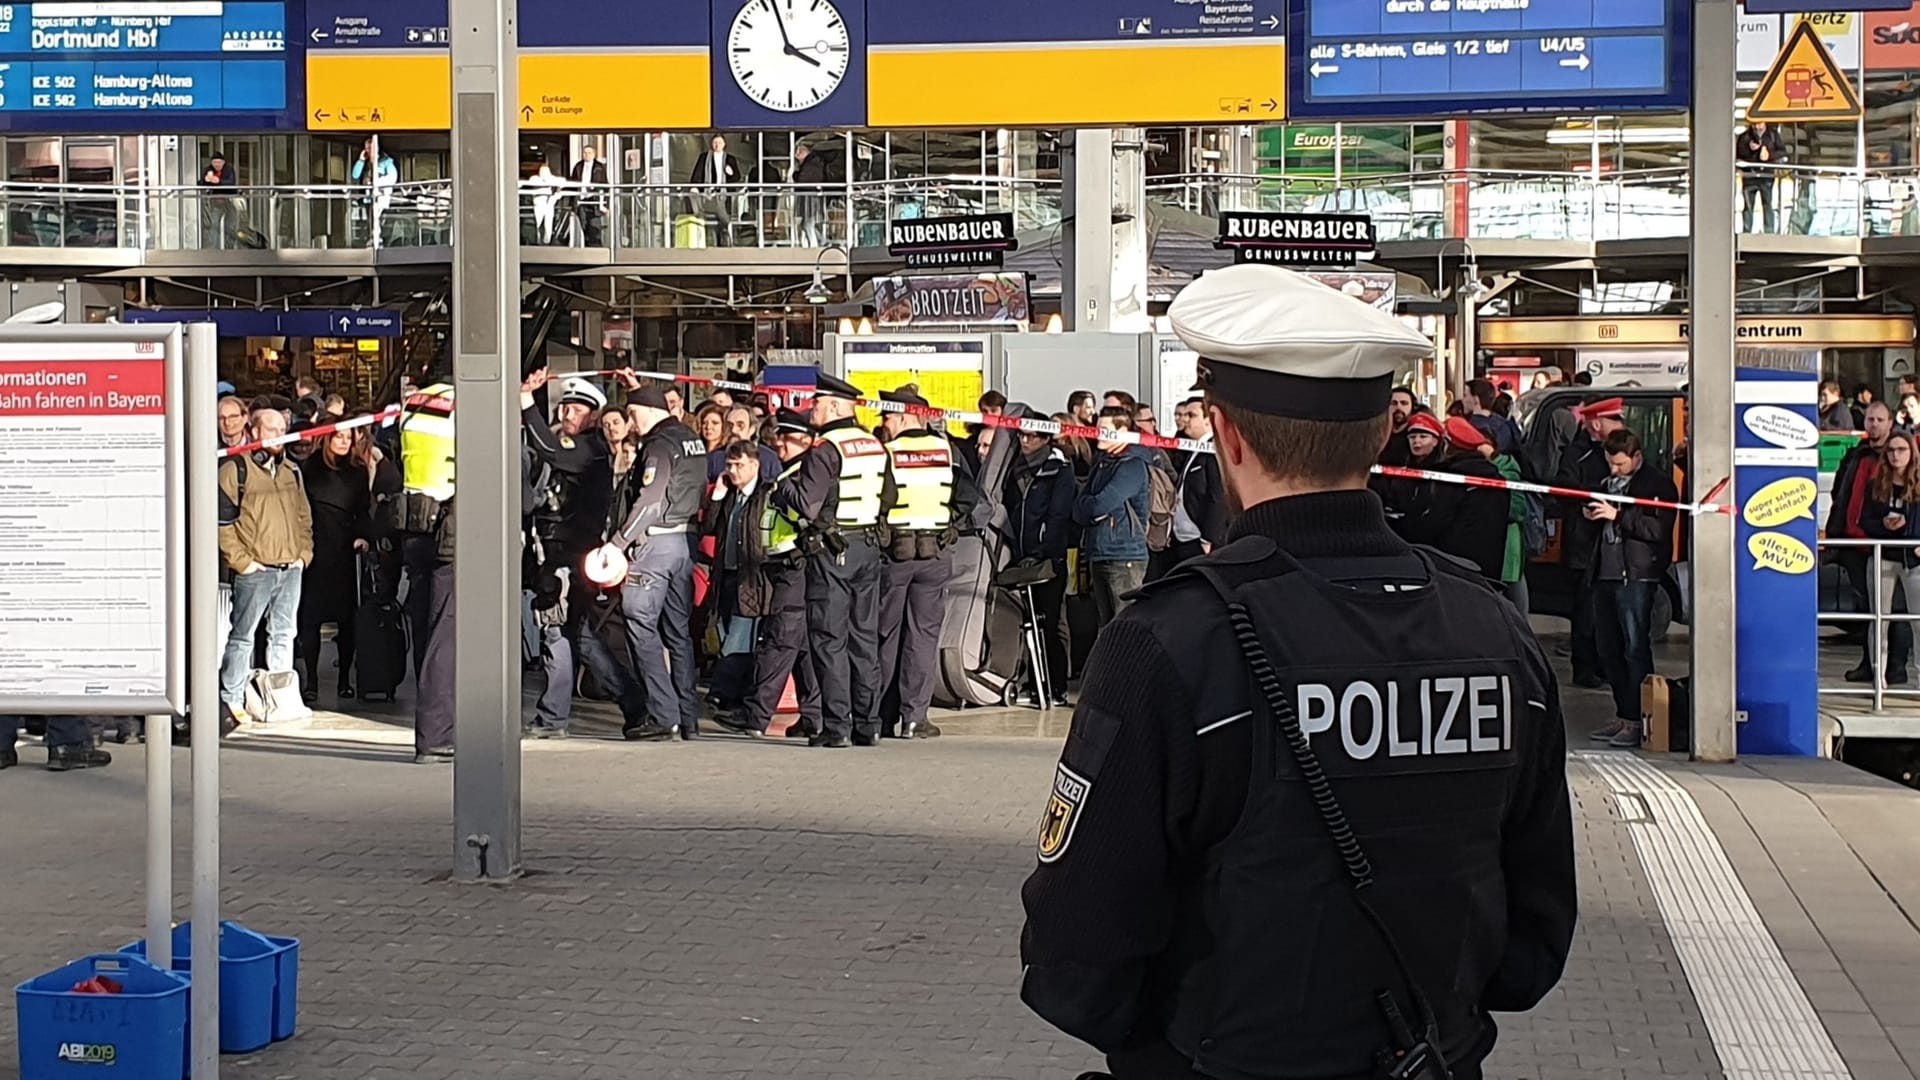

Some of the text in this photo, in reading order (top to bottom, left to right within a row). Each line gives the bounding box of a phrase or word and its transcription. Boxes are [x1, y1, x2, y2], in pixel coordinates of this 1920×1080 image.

[1386, 0, 1528, 12] durch die Haupthalle
[32, 28, 158, 48] Dortmund Hbf
[1540, 37, 1585, 52] U4/U5
[1310, 39, 1509, 58] alle S-Bahnen, Gleis 1/2 tief
[33, 74, 193, 90] ICE 502 Hamburg-Altona
[33, 94, 51, 106] ICE
[94, 92, 193, 108] Hamburg-Altona
[1294, 133, 1363, 149] Europcar
[908, 251, 993, 265] GENUSSWELTEN
[1245, 249, 1352, 261] GENUSSWELTEN
[912, 288, 985, 317] BROTZEIT
[1600, 326, 1617, 337] DB
[890, 344, 936, 353] Information
[35, 392, 85, 408] fahren
[89, 392, 103, 407] in
[108, 391, 162, 411] Bayern
[1748, 483, 1807, 514] super schnell
[1755, 494, 1808, 521] und einfach
[1758, 537, 1809, 563] alles im
[1762, 550, 1794, 568] MVV
[1297, 675, 1511, 760] POLIZEI
[58, 1042, 116, 1060] ABI2019
